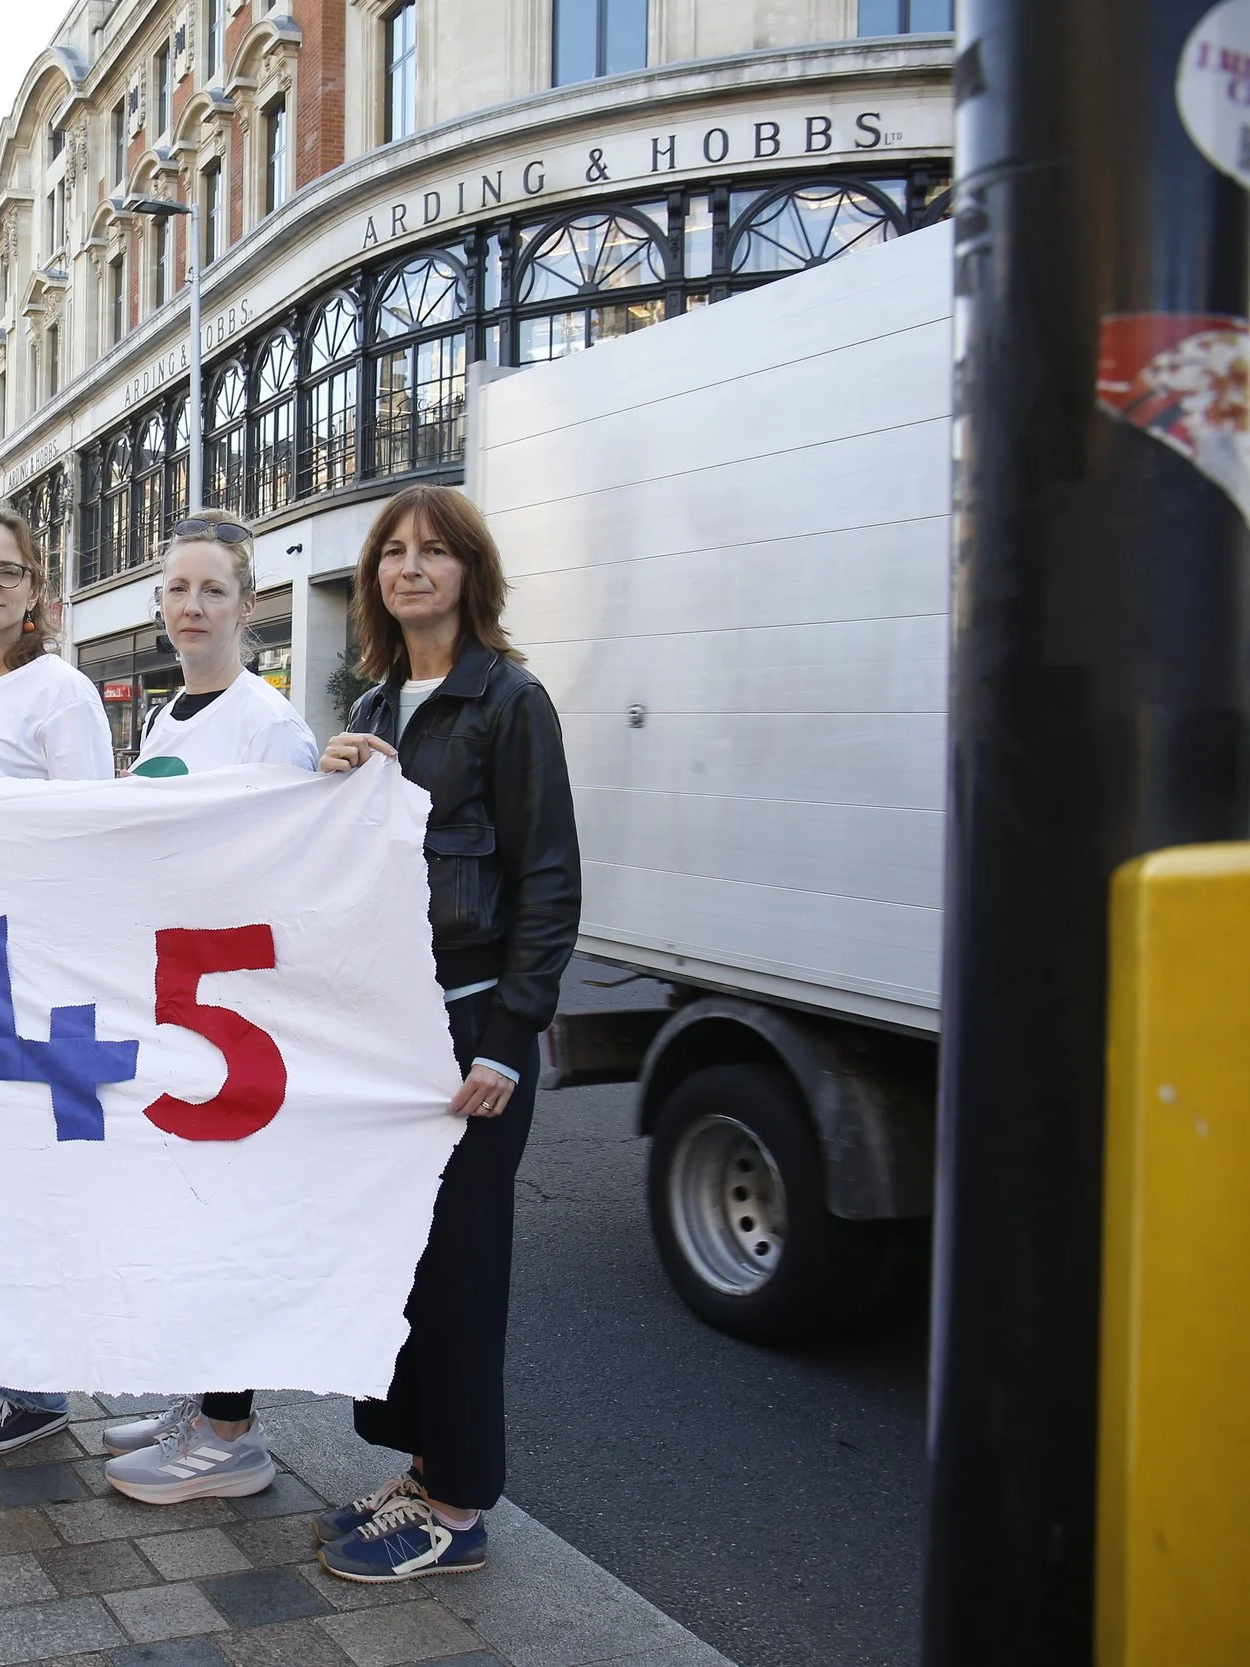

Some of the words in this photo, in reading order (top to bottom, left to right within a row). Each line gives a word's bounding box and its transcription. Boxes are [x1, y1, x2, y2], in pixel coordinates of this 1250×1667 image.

[362, 159, 546, 249] ARDING
[584, 147, 610, 183] &
[650, 111, 884, 173] HOBBS
[124, 352, 175, 408] ARDING
[180, 344, 187, 368] &
[200, 298, 248, 355] OBBS
